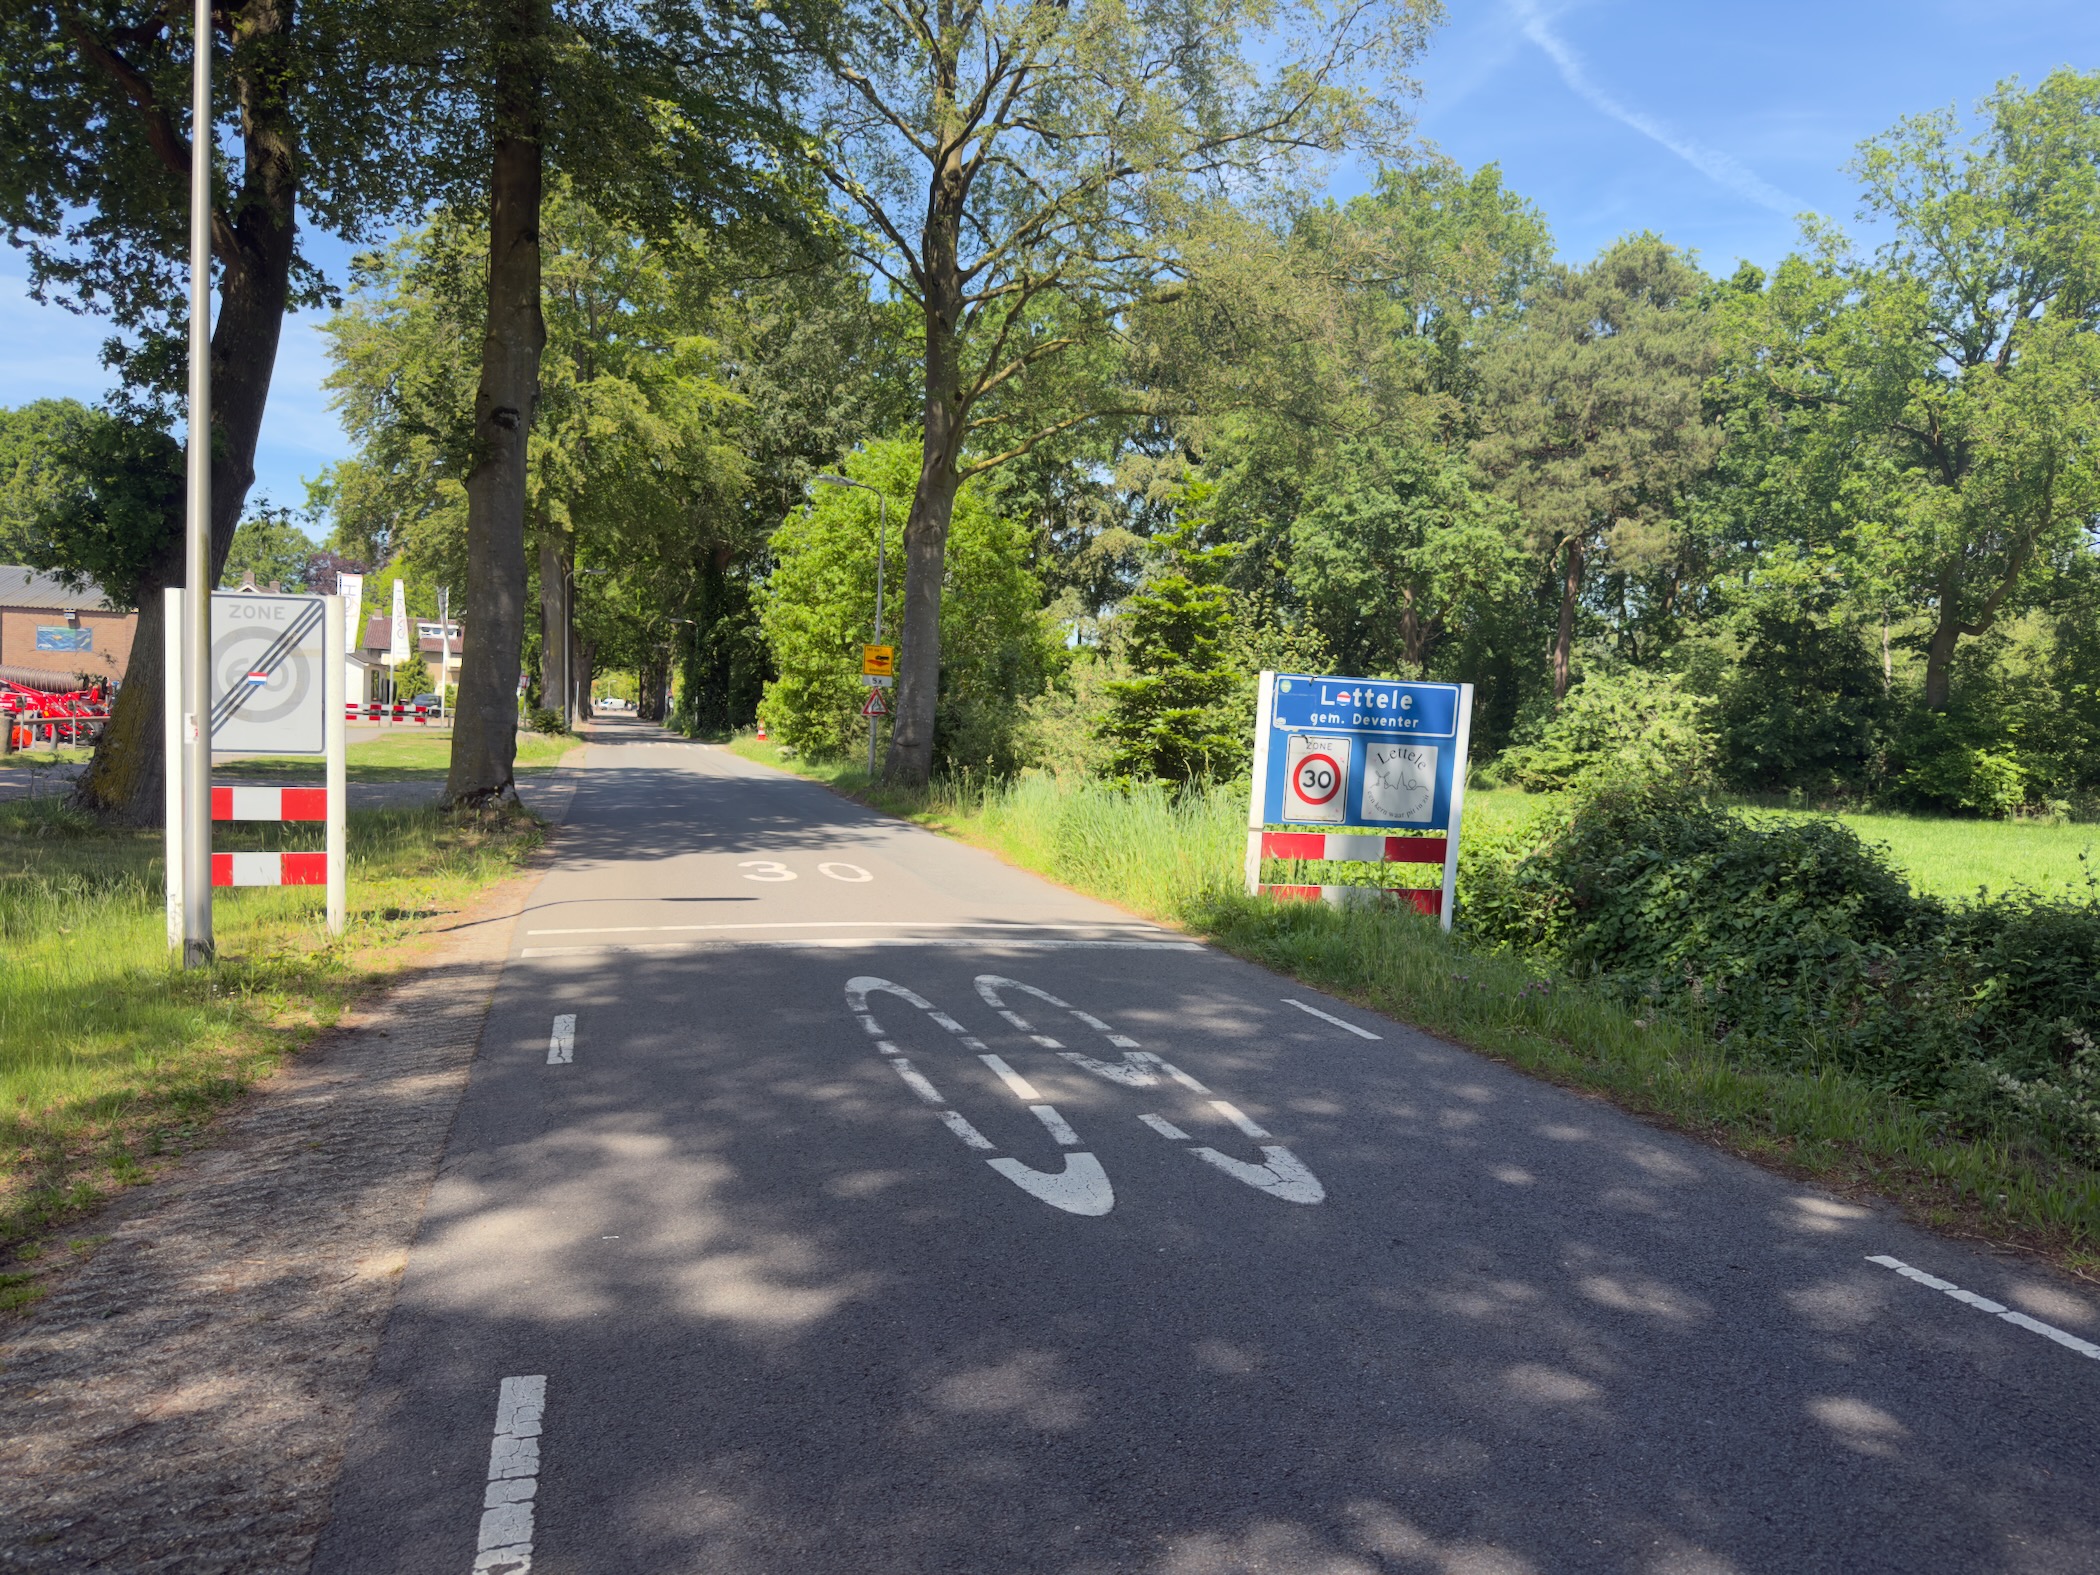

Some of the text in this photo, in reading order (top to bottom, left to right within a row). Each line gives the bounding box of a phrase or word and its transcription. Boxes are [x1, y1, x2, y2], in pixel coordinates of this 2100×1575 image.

[229, 604, 285, 620] ZONE
[1321, 685, 1413, 710] Lttele
[1310, 713, 1419, 729] gem. Deventer
[1306, 741, 1333, 751] ZONE
[1376, 747, 1427, 770] Lettele
[1302, 769, 1332, 789] 30
[1374, 802, 1388, 816] kern
[1388, 811, 1405, 819] waar
[737, 860, 874, 883] 30
